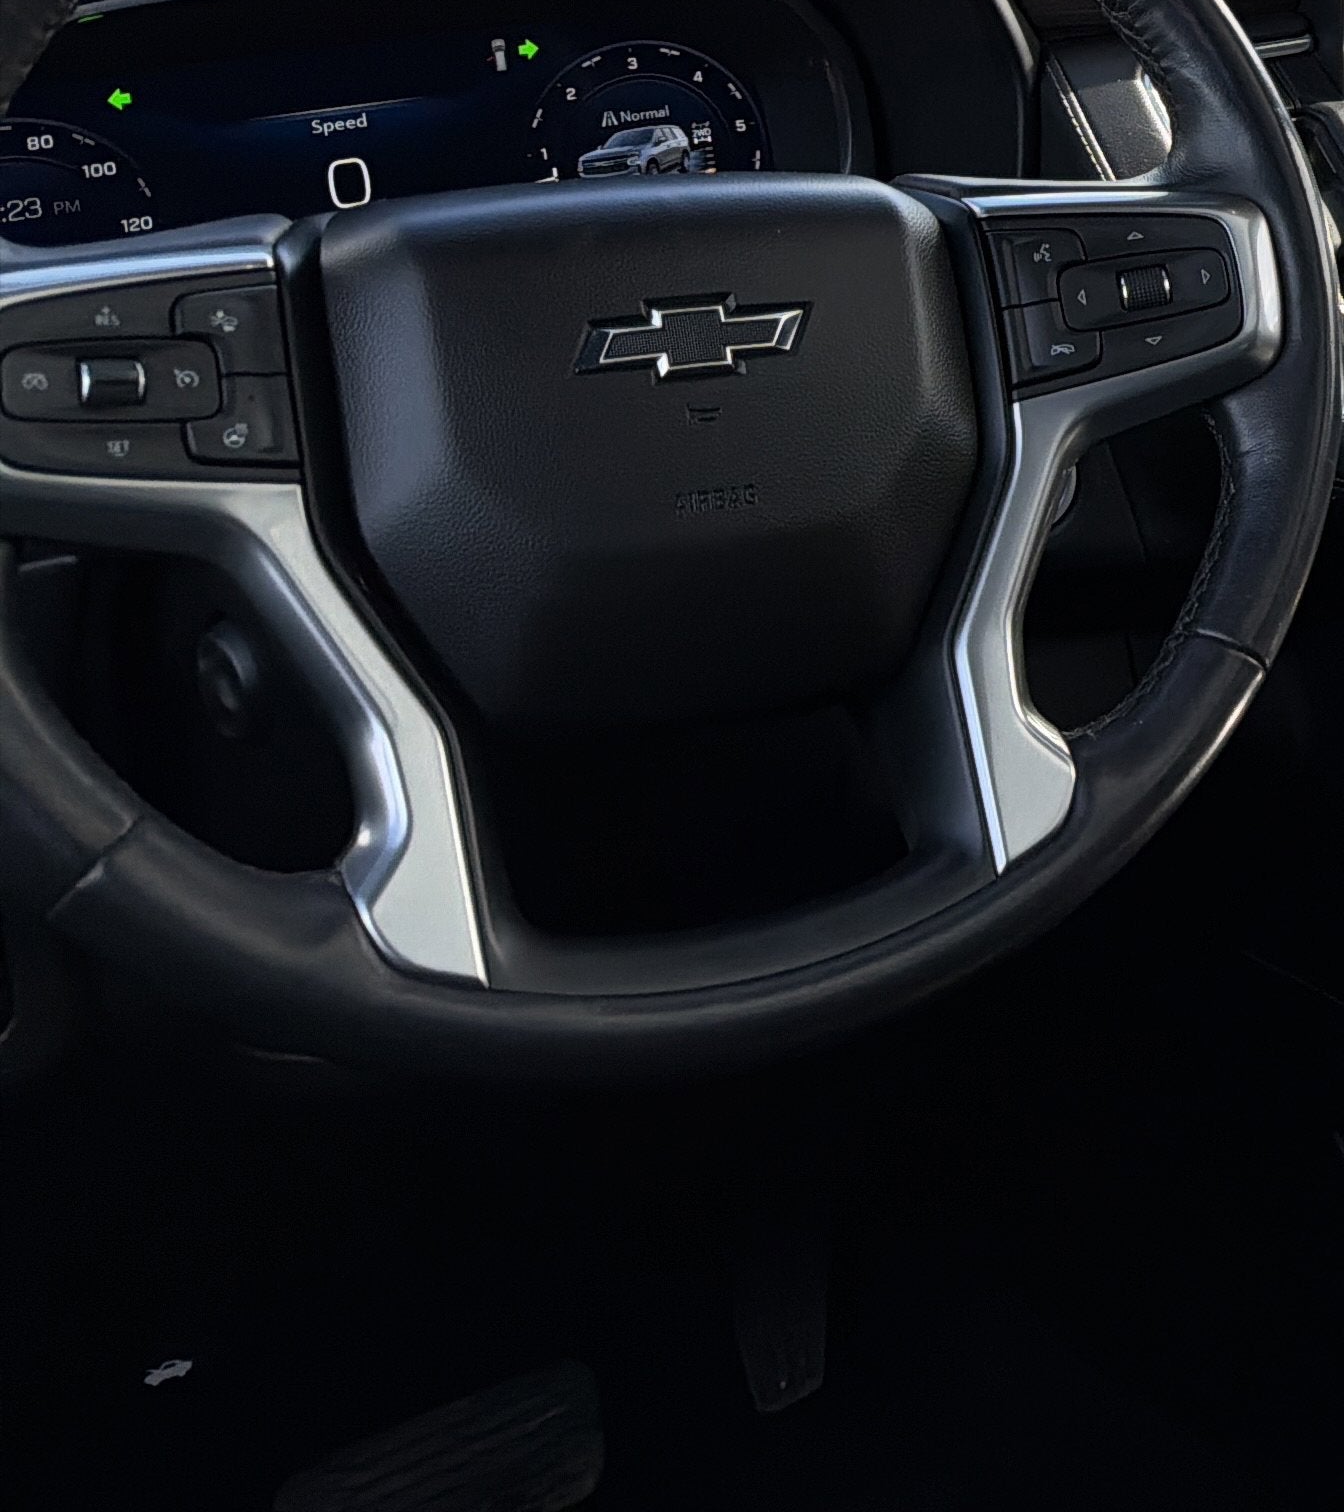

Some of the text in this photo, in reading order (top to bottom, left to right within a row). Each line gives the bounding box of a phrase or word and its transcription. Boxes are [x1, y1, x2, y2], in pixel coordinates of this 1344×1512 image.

[627, 57, 638, 70] 3
[692, 71, 703, 83] 4
[565, 88, 577, 101] 2
[620, 105, 670, 123] Normal
[311, 112, 368, 137] Speed
[735, 119, 747, 132] 5
[26, 134, 54, 151] 80
[540, 147, 548, 161] 1
[81, 161, 117, 179] 100
[327, 157, 371, 209] 0
[53, 199, 81, 215] PM
[120, 216, 153, 233] 120
